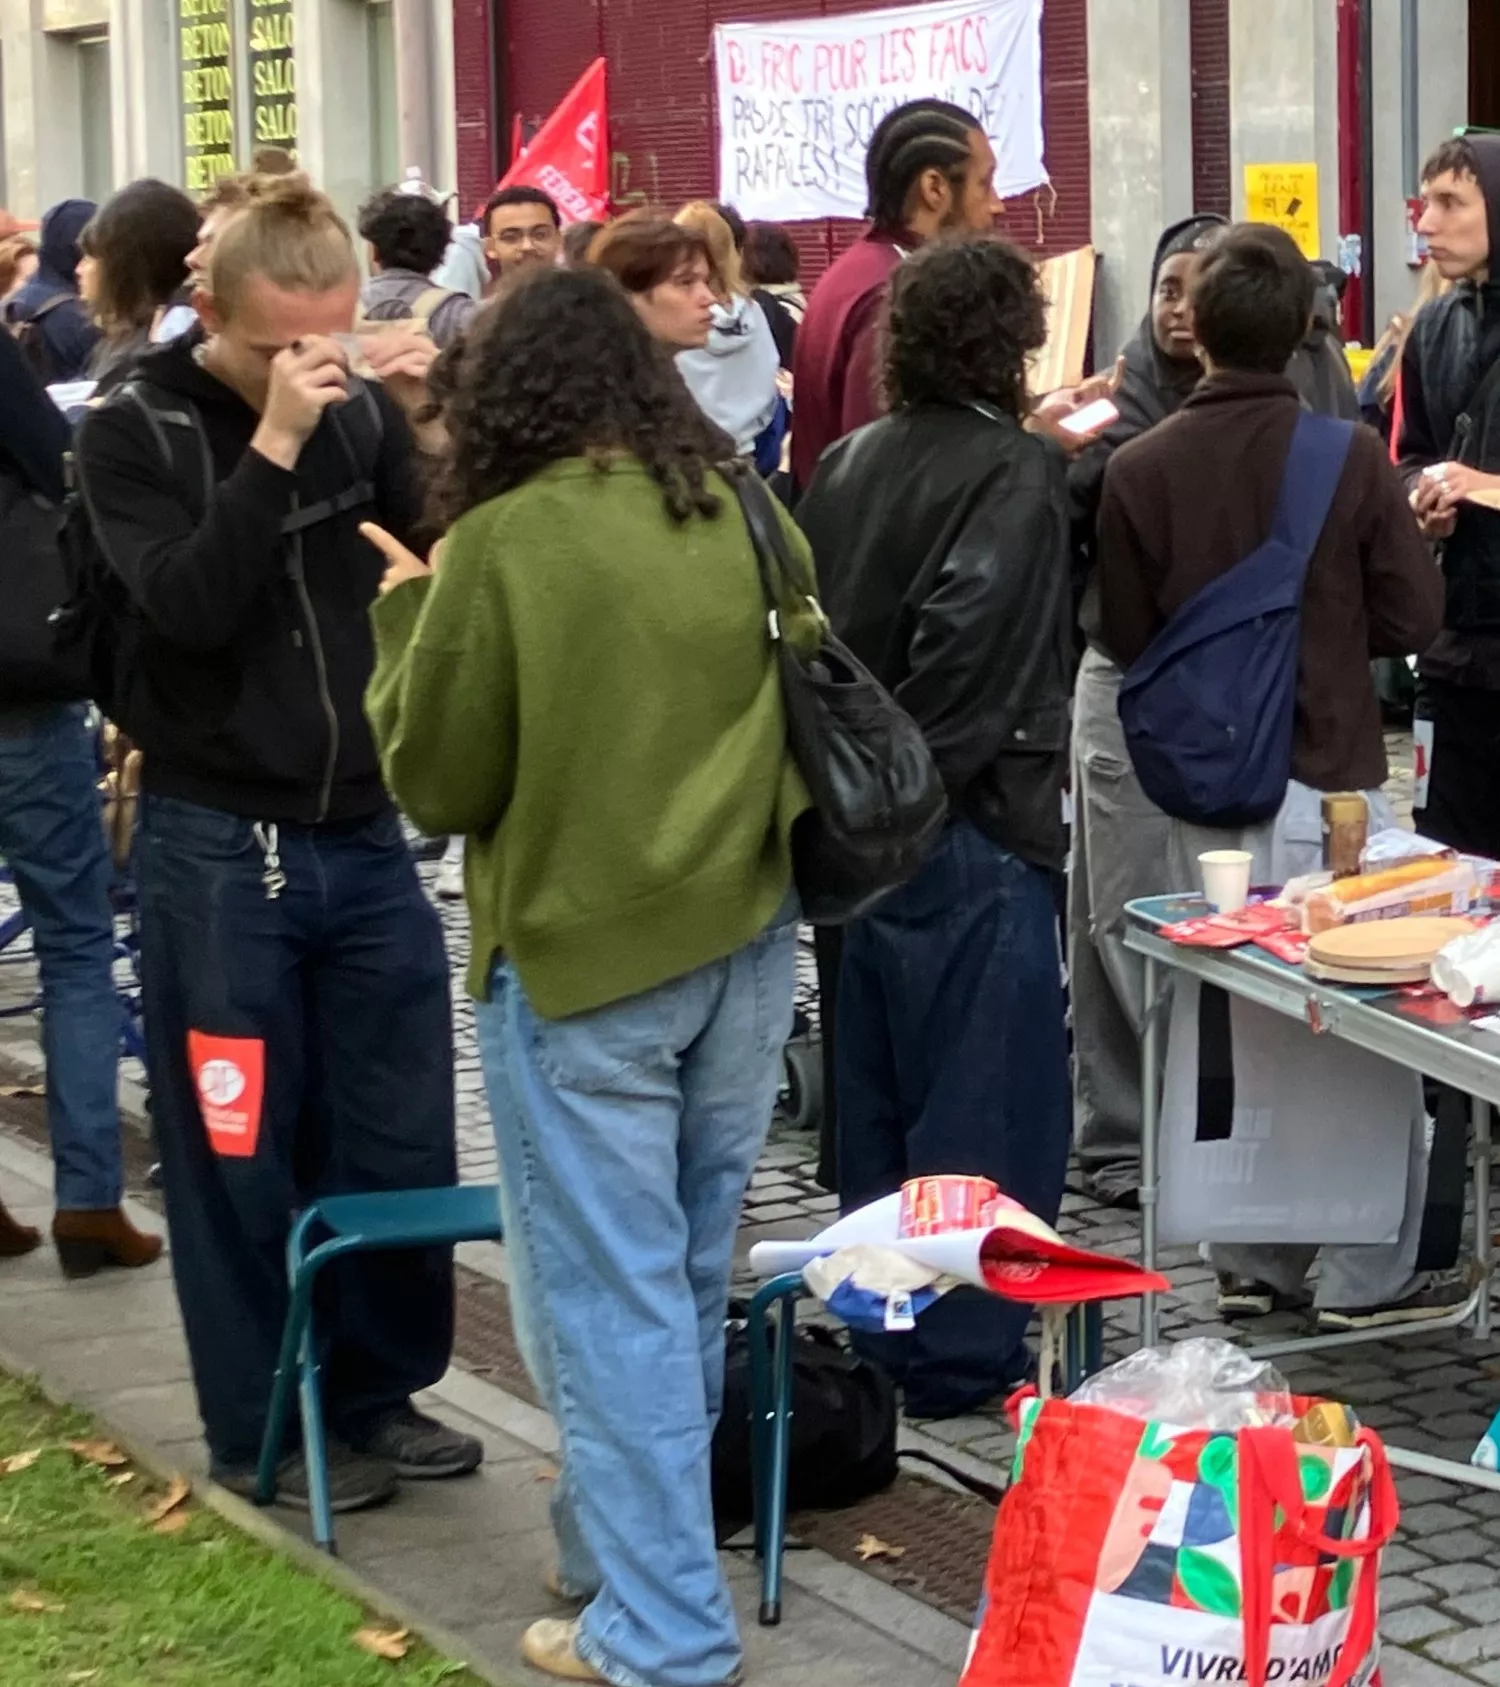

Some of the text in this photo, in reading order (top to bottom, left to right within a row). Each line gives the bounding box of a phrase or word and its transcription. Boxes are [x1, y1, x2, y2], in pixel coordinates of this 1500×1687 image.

[814, 39, 868, 92] POUR
[880, 28, 916, 84] LES
[928, 15, 990, 81] FACS
[732, 95, 765, 139] PAS
[800, 95, 836, 142] TRI
